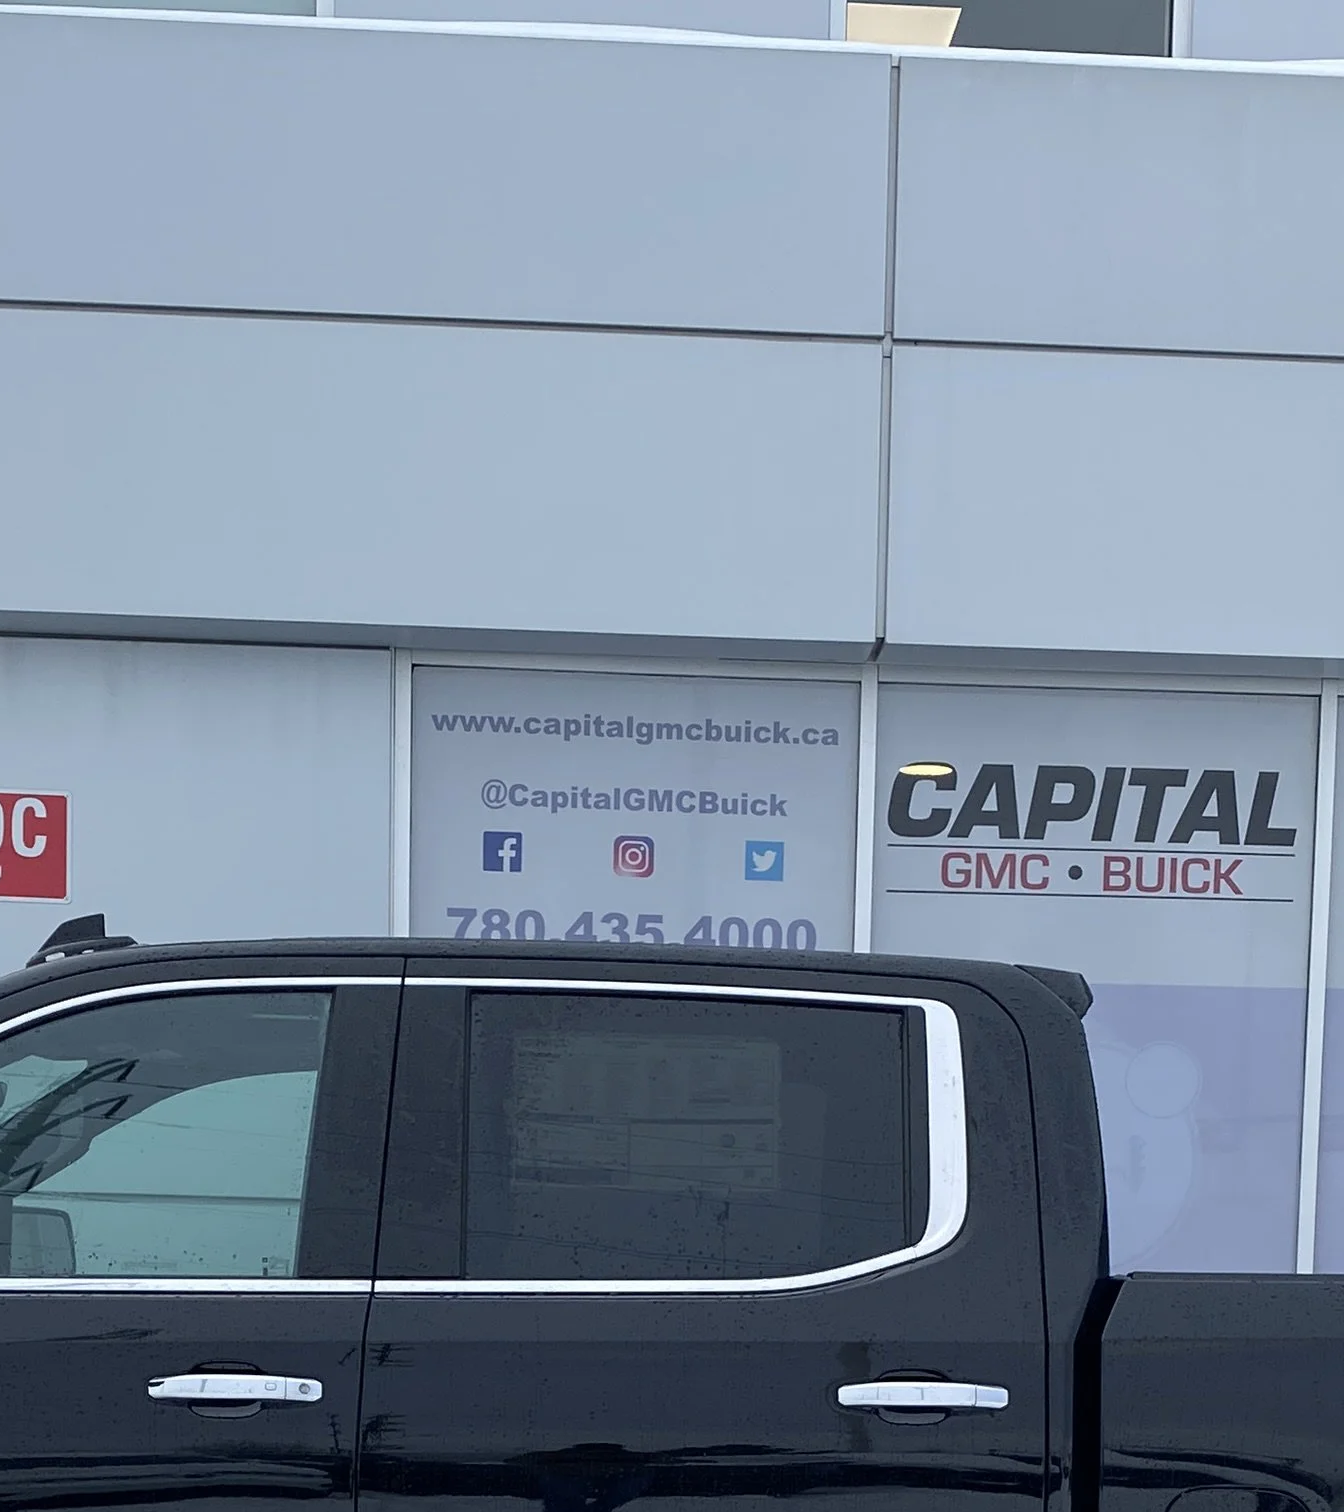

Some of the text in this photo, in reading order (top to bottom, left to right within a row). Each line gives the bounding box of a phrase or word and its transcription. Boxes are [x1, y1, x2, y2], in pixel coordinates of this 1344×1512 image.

[431, 713, 840, 746] www.capitalgmcbuick.ca
[480, 778, 789, 817] @CapitalGMCBuick
[887, 761, 1298, 847] CAPITAL
[940, 851, 1244, 896] GMC BUICK
[446, 906, 818, 951] 7804354000
